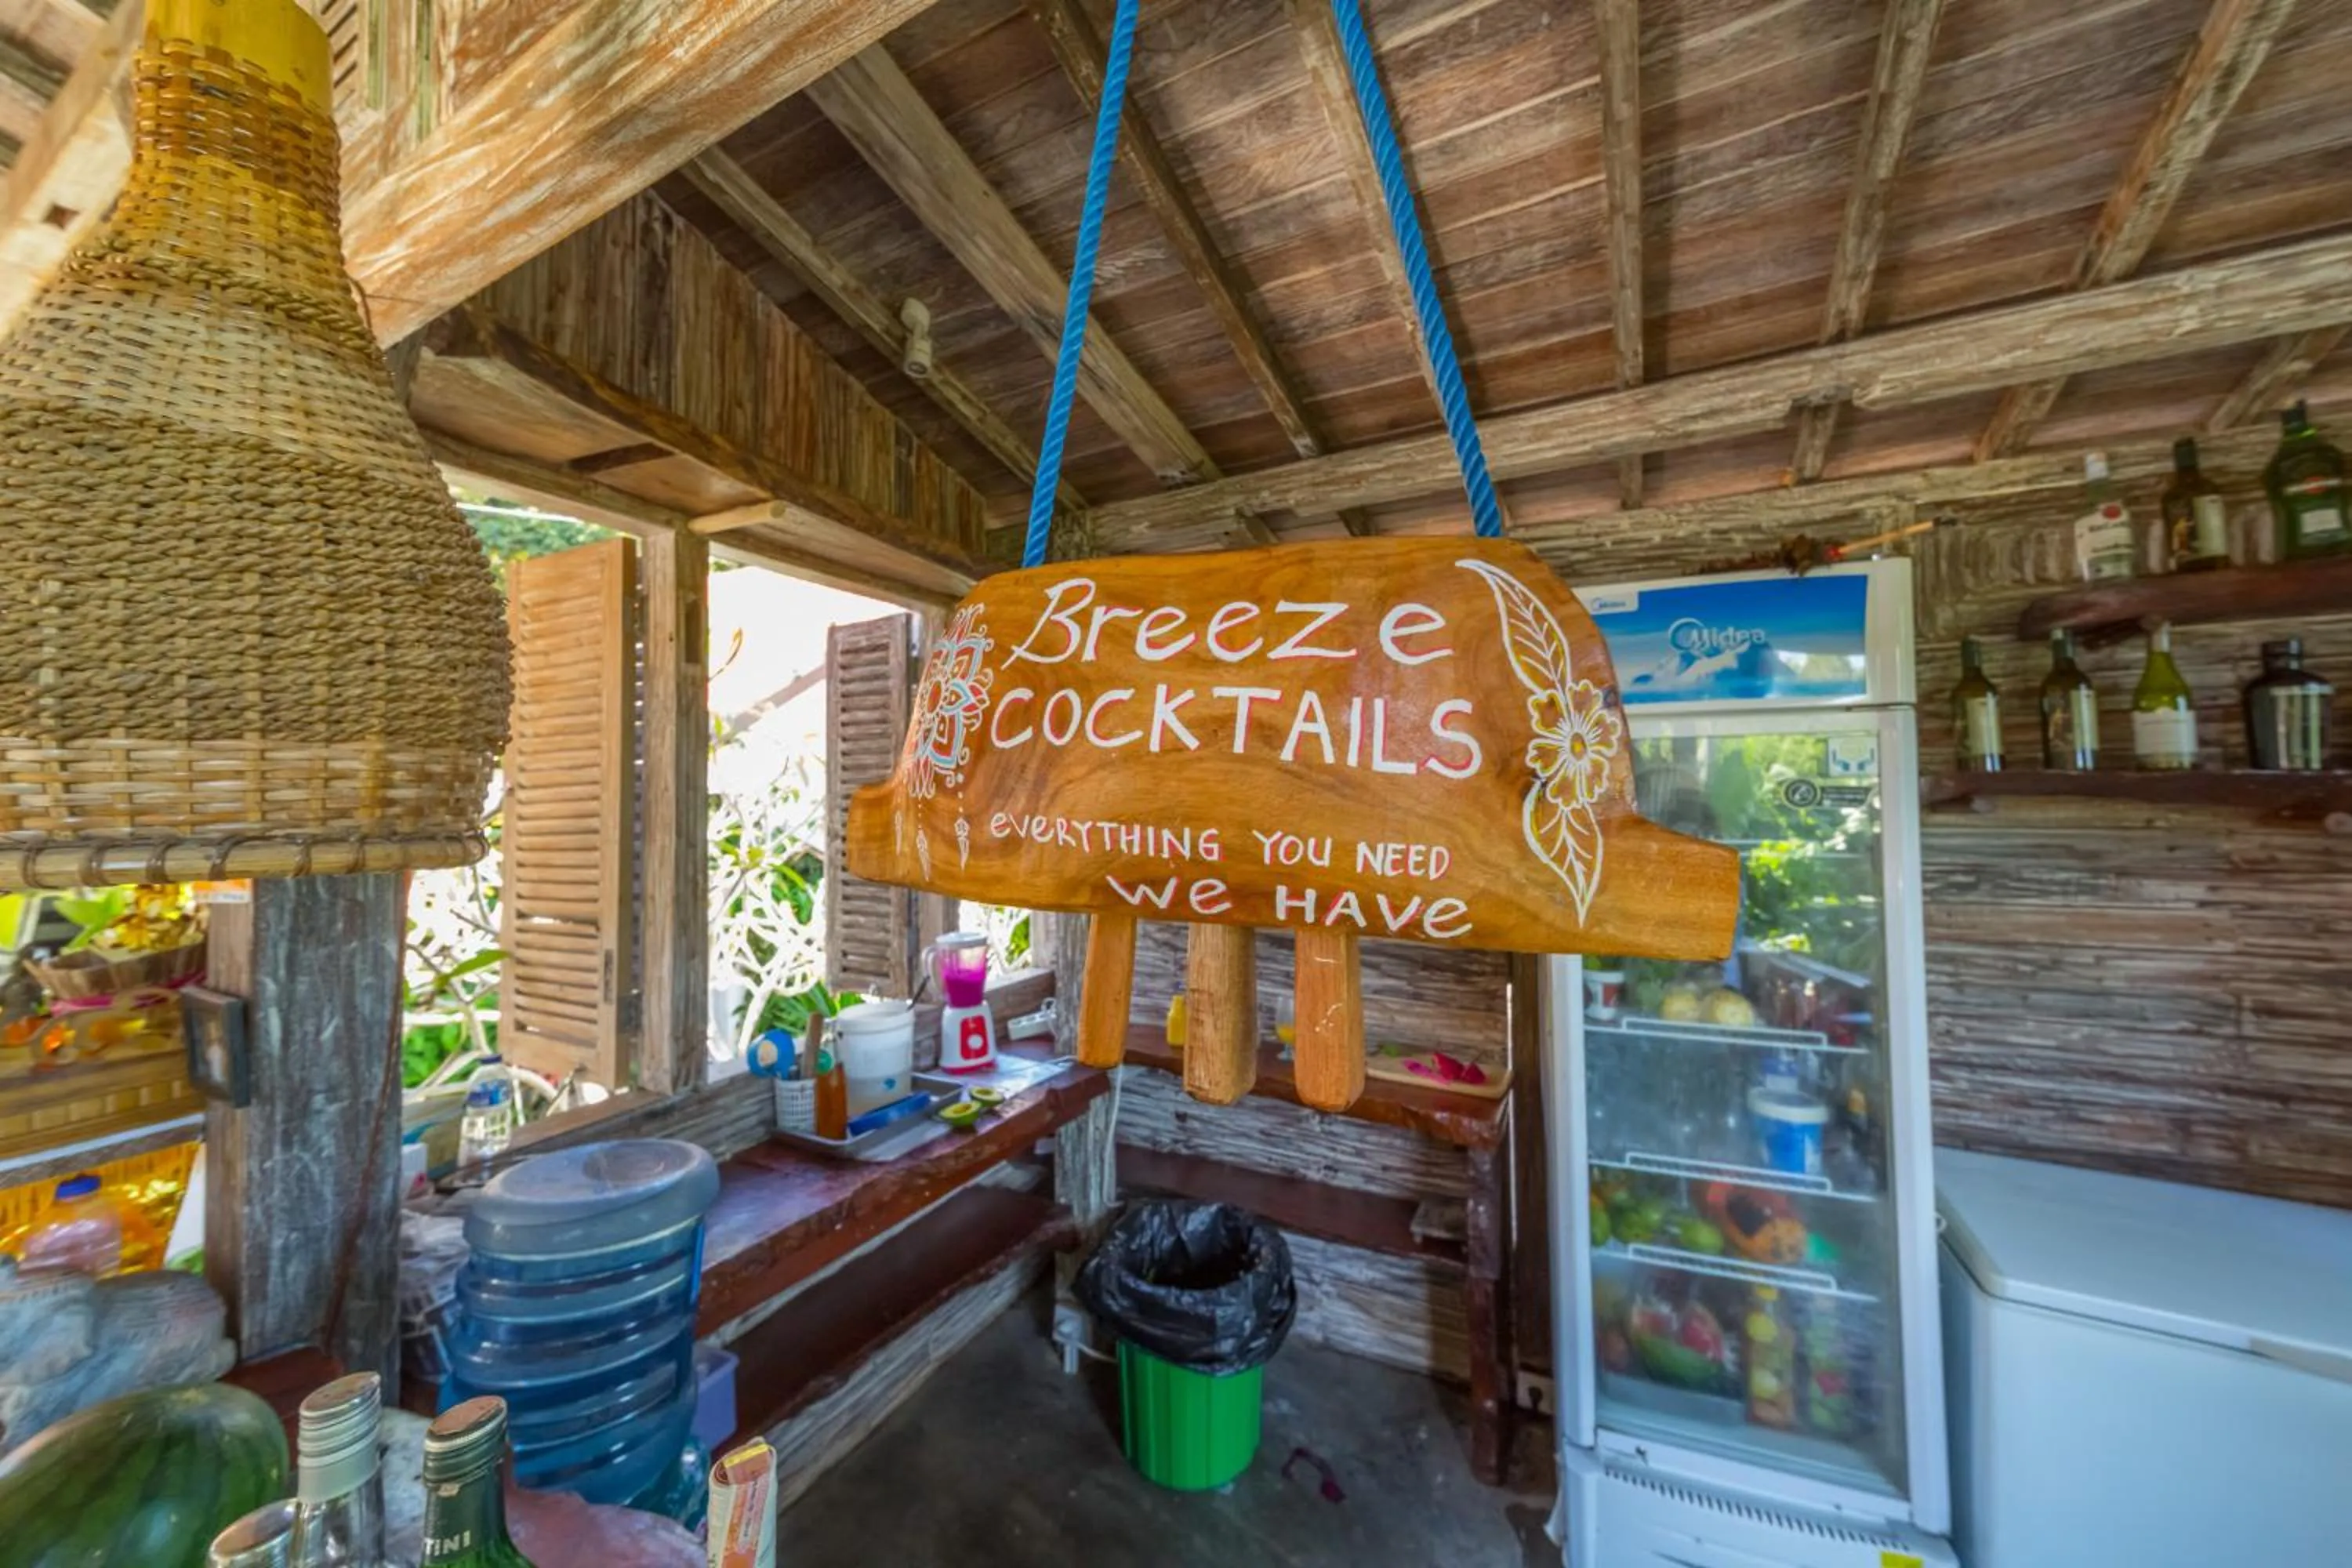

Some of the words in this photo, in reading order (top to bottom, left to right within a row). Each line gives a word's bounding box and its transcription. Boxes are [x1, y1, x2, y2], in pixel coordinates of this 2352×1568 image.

[1001, 578, 1454, 670] Breeze
[1678, 621, 1766, 652] Midea
[991, 683, 1482, 779] COCKTAILS
[1252, 829, 1331, 867] YOU
[1356, 841, 1450, 880] NEED
